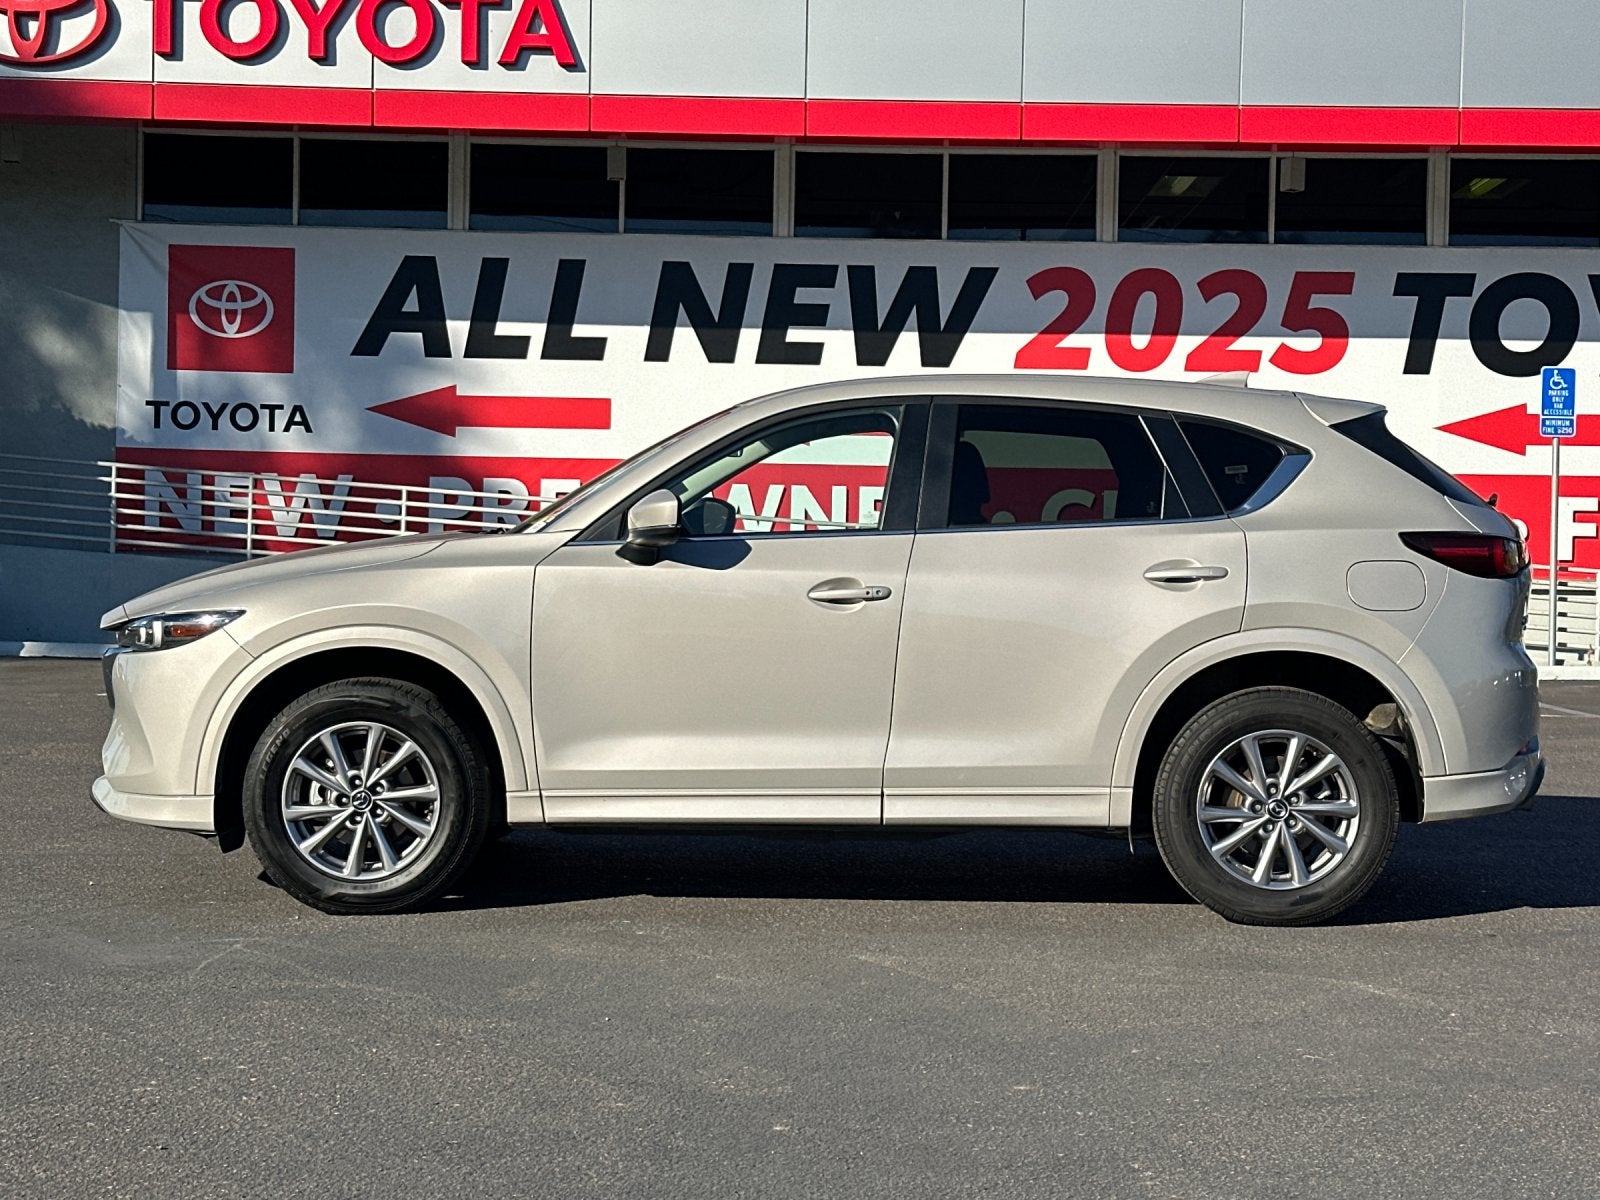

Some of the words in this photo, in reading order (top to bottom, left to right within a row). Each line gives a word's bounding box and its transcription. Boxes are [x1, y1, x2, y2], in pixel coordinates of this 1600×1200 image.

[153, 0, 578, 66] TOYOTA
[349, 254, 609, 361] ALL
[643, 260, 1000, 367] NEW
[1013, 265, 1355, 375] 2025
[1391, 271, 1600, 377] TO
[145, 399, 313, 434] TOYOTA
[143, 470, 353, 538] NEW
